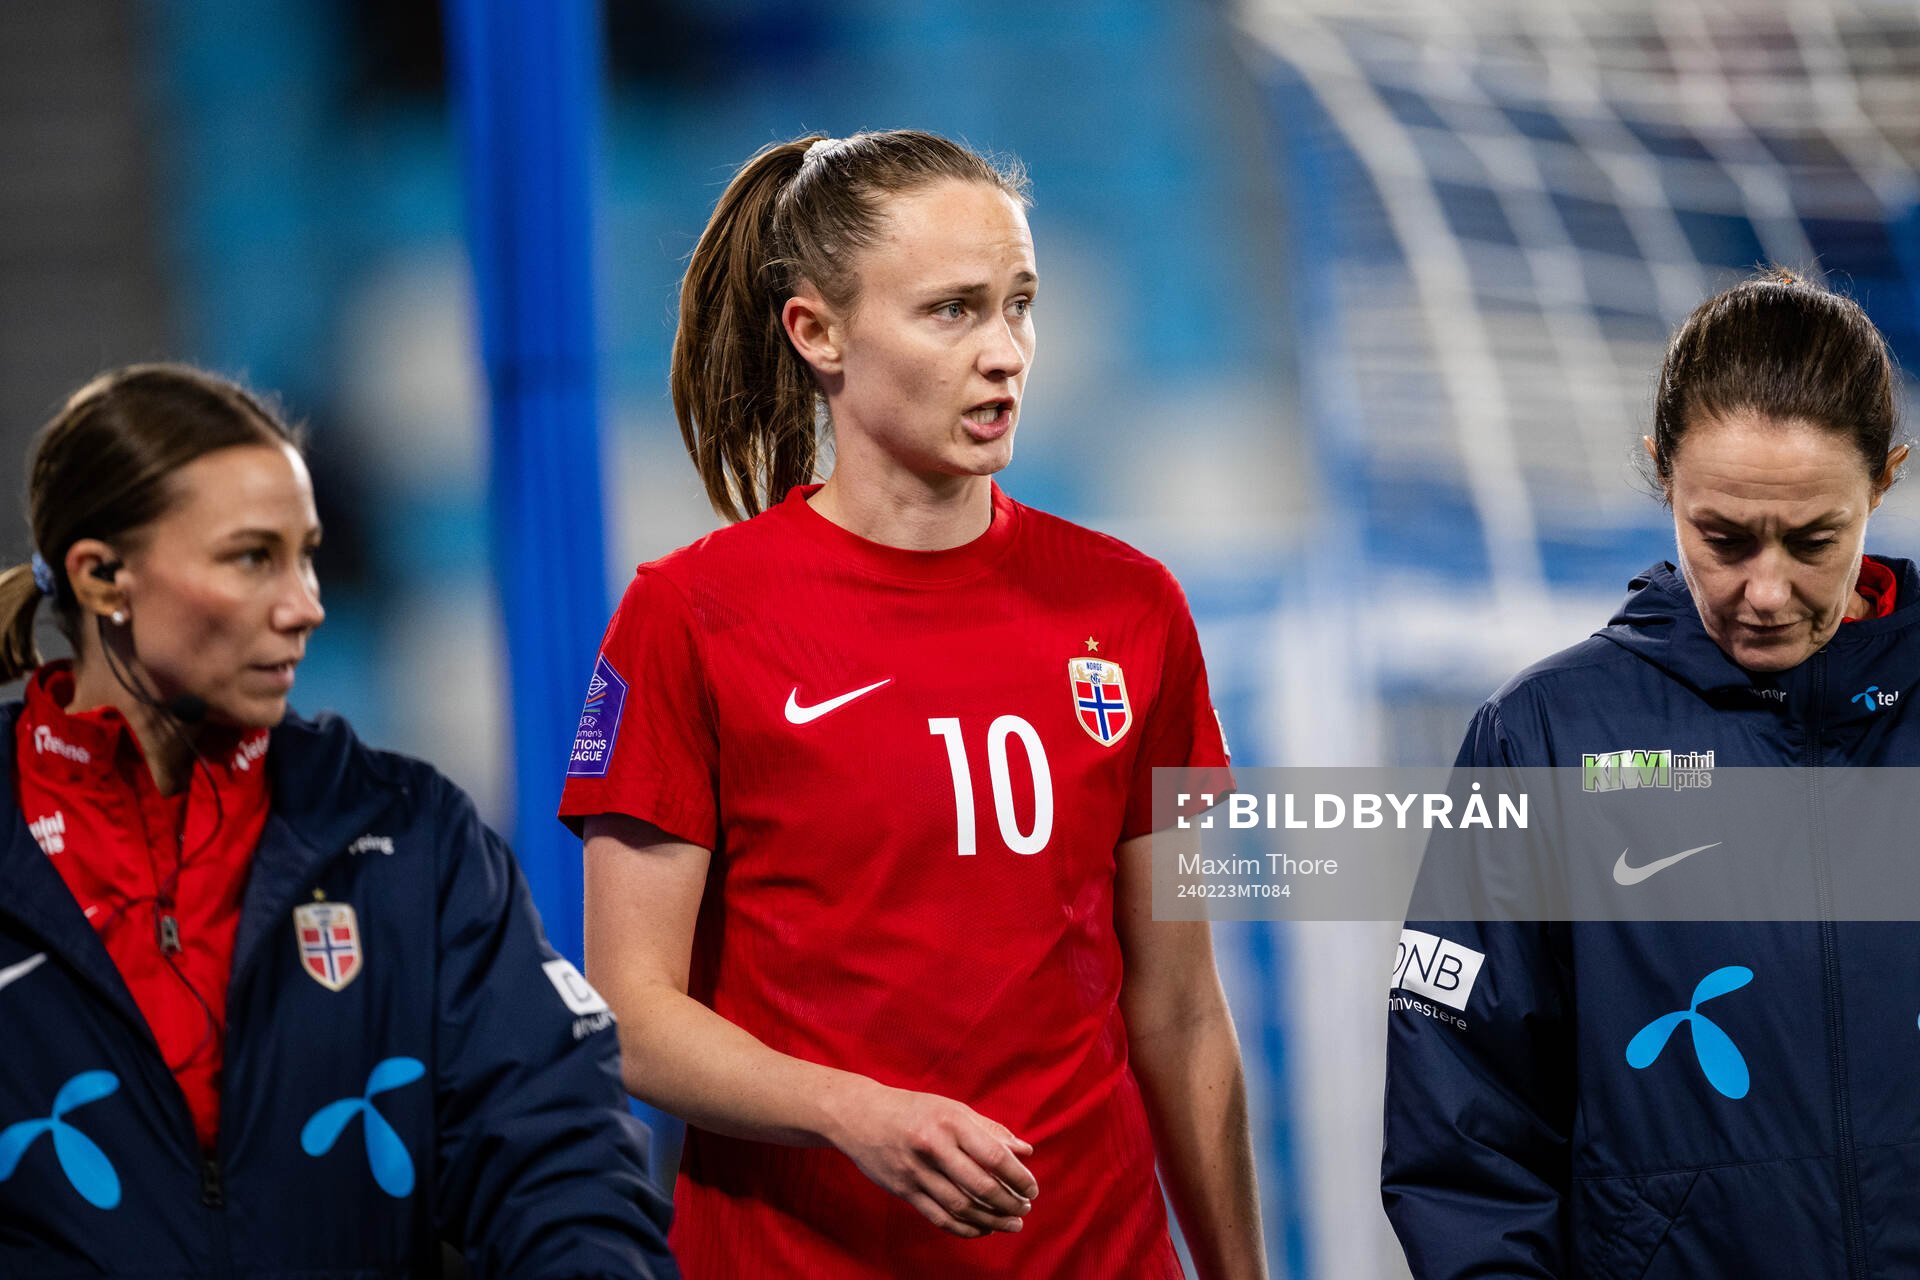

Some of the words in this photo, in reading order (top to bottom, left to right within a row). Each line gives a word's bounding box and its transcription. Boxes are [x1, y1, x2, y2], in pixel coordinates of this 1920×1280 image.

[1877, 690, 1899, 706] tel
[573, 739, 607, 750] TIONS
[570, 751, 603, 761] EAGUE
[1674, 751, 1715, 770] mini
[1583, 750, 1671, 792] KIWI
[1674, 770, 1712, 791] pris
[928, 714, 1055, 856] 10
[1389, 994, 1467, 1030] ninvestere
